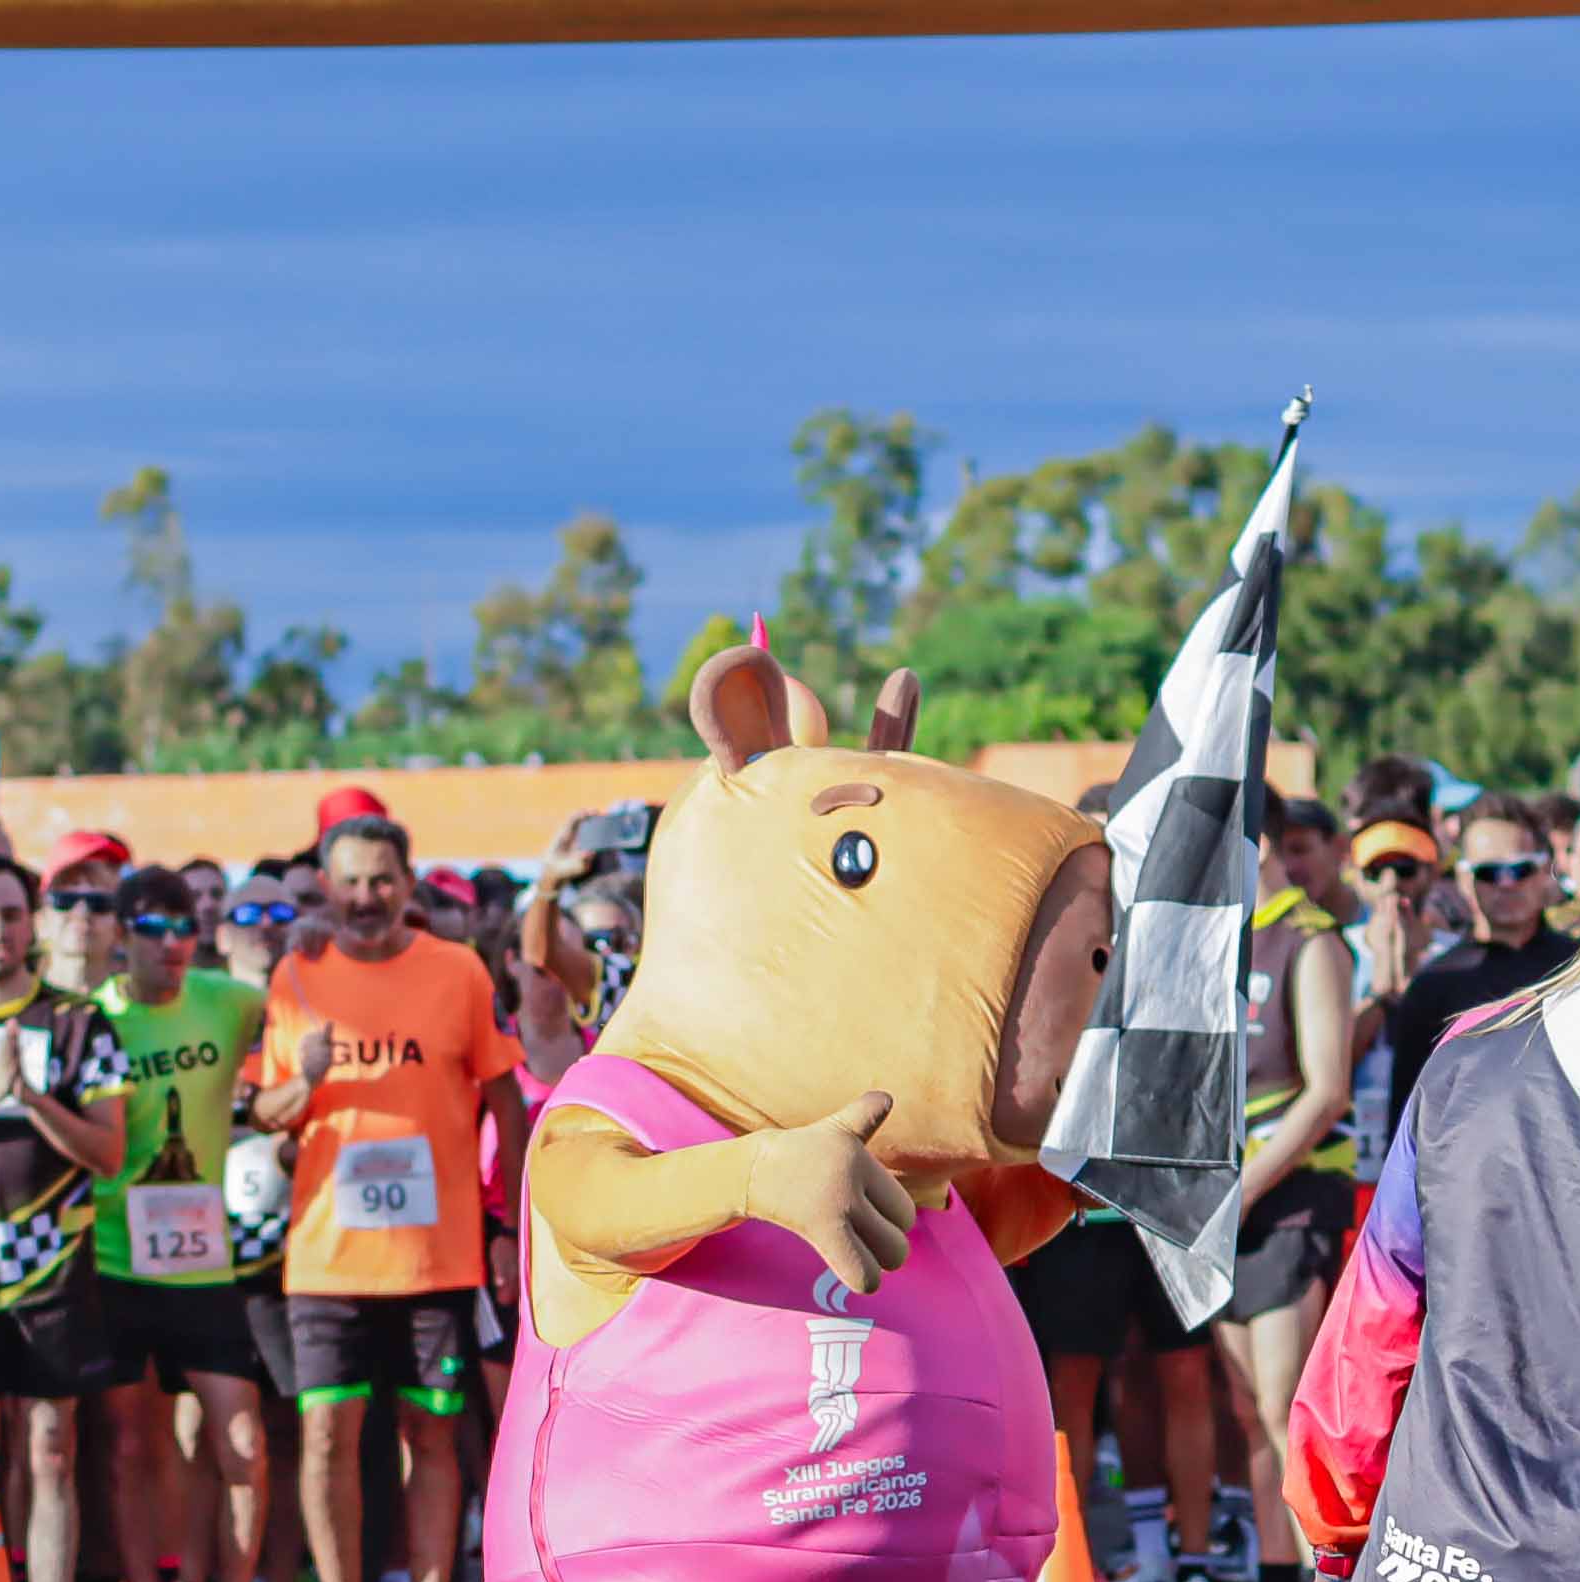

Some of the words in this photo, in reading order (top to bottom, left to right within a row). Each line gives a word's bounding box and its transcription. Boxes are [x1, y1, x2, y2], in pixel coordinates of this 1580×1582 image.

[361, 1182, 407, 1213] 90
[147, 1231, 210, 1260] 125
[784, 1463, 821, 1485] XIII
[825, 1455, 906, 1479] Juegos
[762, 1471, 927, 1507] Suramericanos
[770, 1504, 837, 1525] Santa
[841, 1498, 869, 1516] Fe
[872, 1489, 922, 1512] 2026
[1384, 1515, 1440, 1570] Santa
[1442, 1545, 1481, 1580] Fe
